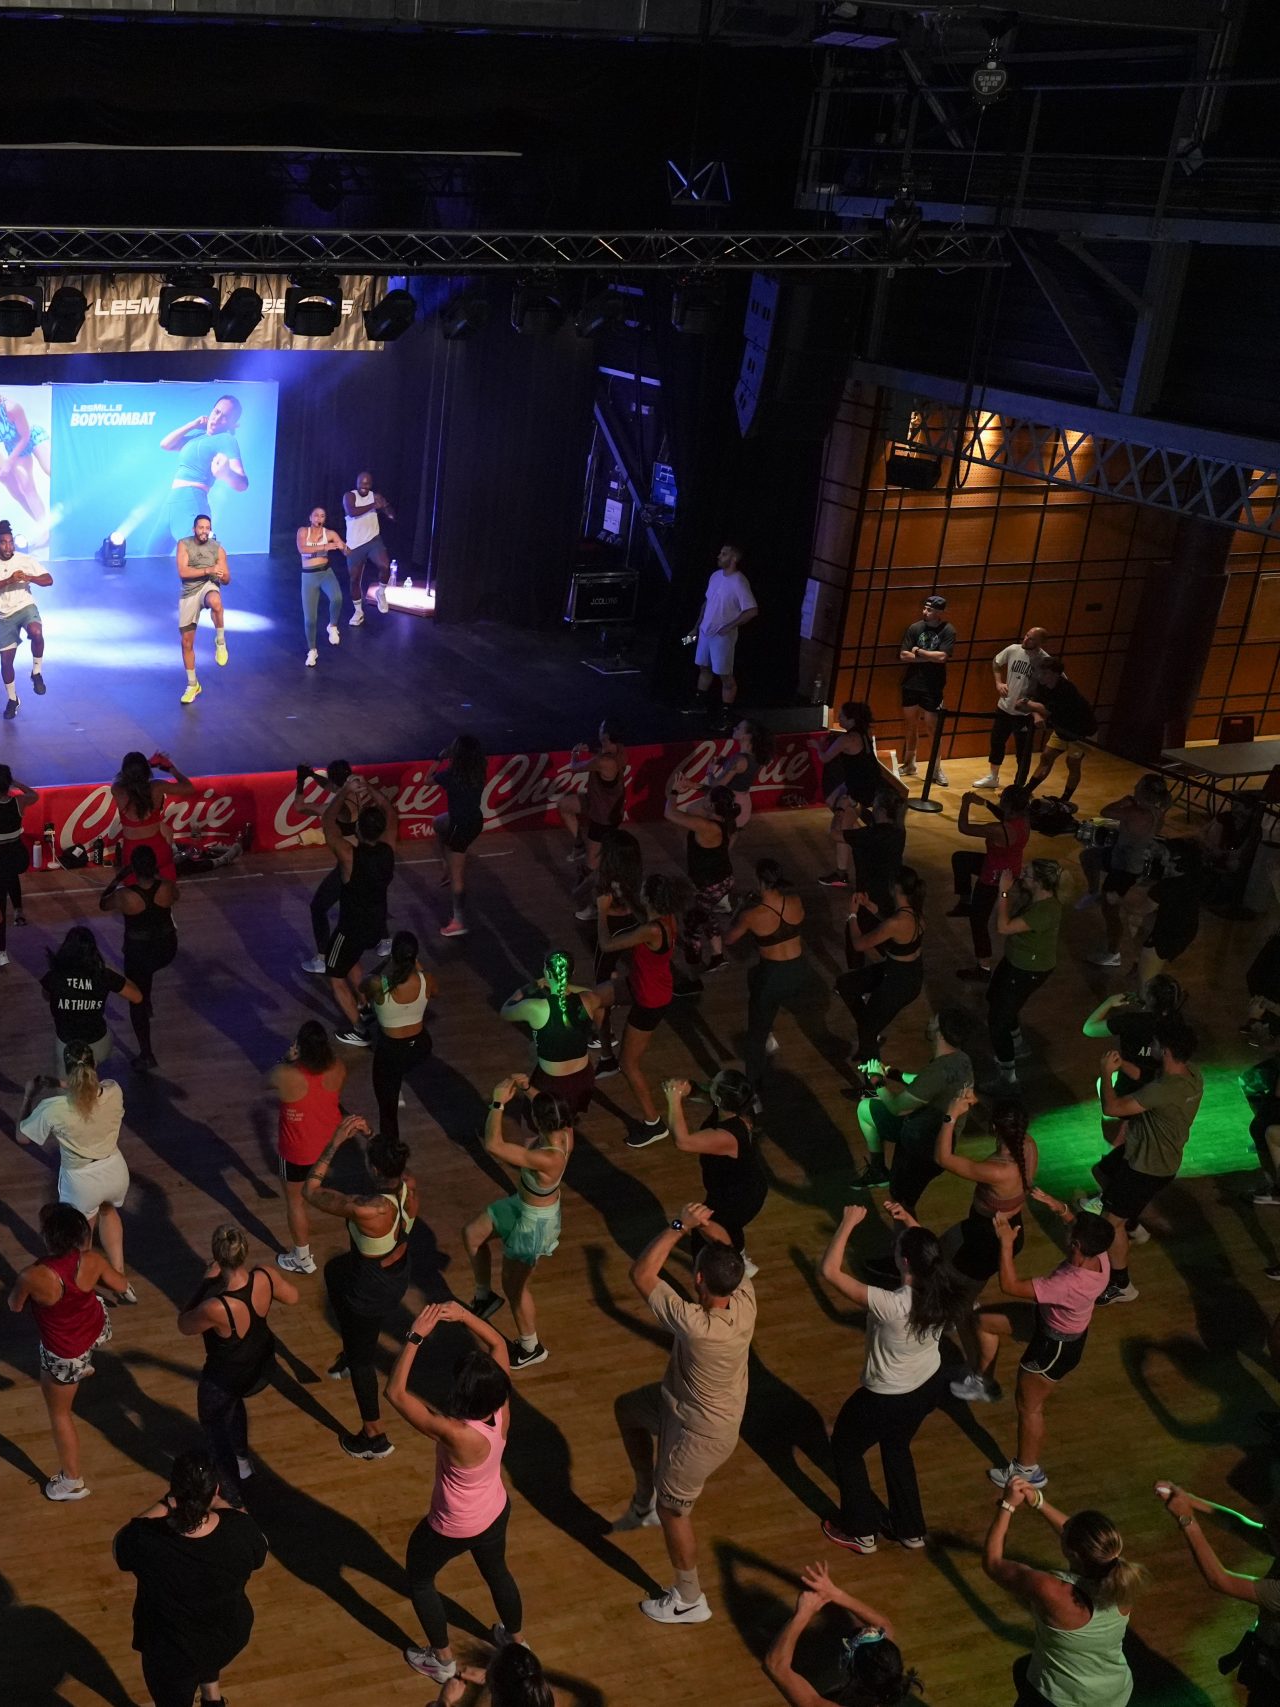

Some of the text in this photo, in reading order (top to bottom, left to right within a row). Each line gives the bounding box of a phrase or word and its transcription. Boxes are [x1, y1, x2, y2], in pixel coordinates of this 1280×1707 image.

[70, 412, 156, 427] BODYCOMBAT
[66, 977, 93, 991] TEAM
[58, 998, 103, 1011] ARTHURS
